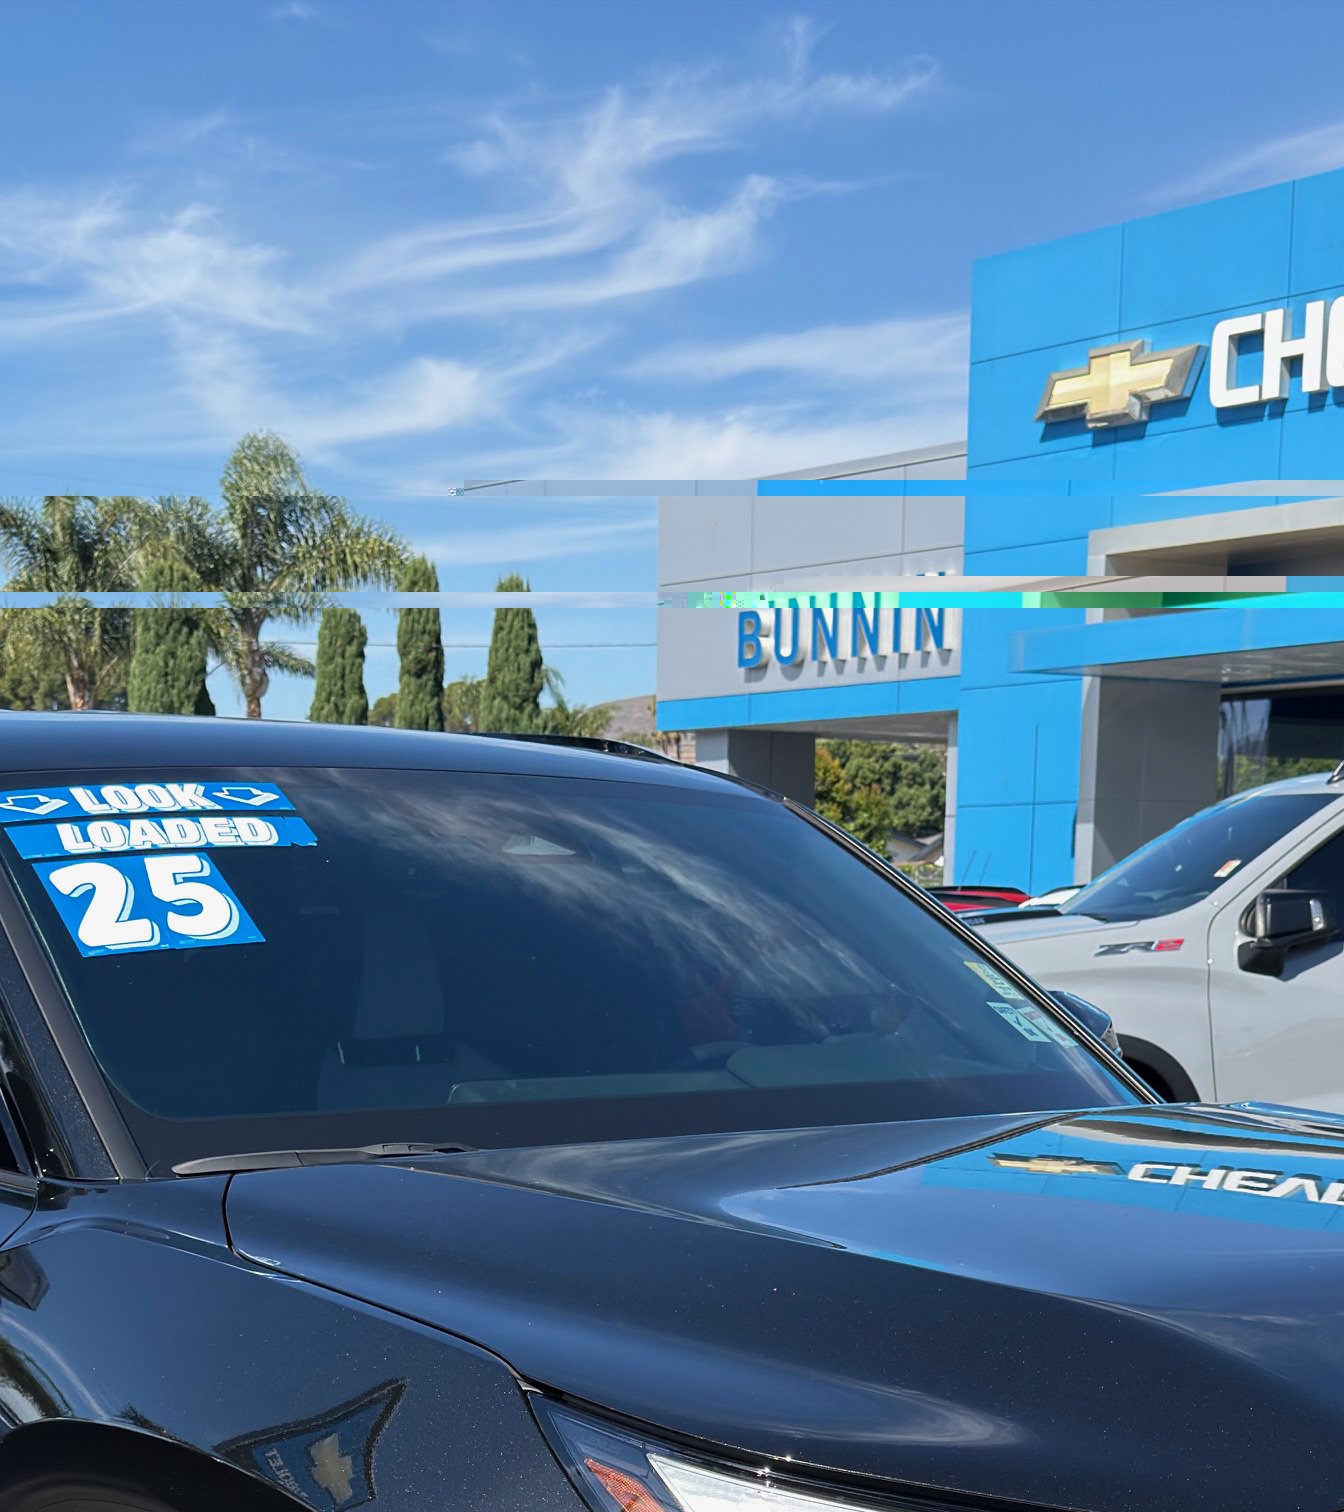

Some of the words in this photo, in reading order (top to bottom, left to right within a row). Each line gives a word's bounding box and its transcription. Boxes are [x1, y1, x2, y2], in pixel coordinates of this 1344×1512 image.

[737, 572, 954, 668] BUNNIN
[69, 783, 220, 814] LOOK
[56, 817, 278, 852] LOADED
[49, 855, 240, 950] 25
[1093, 938, 1184, 958] ZR2
